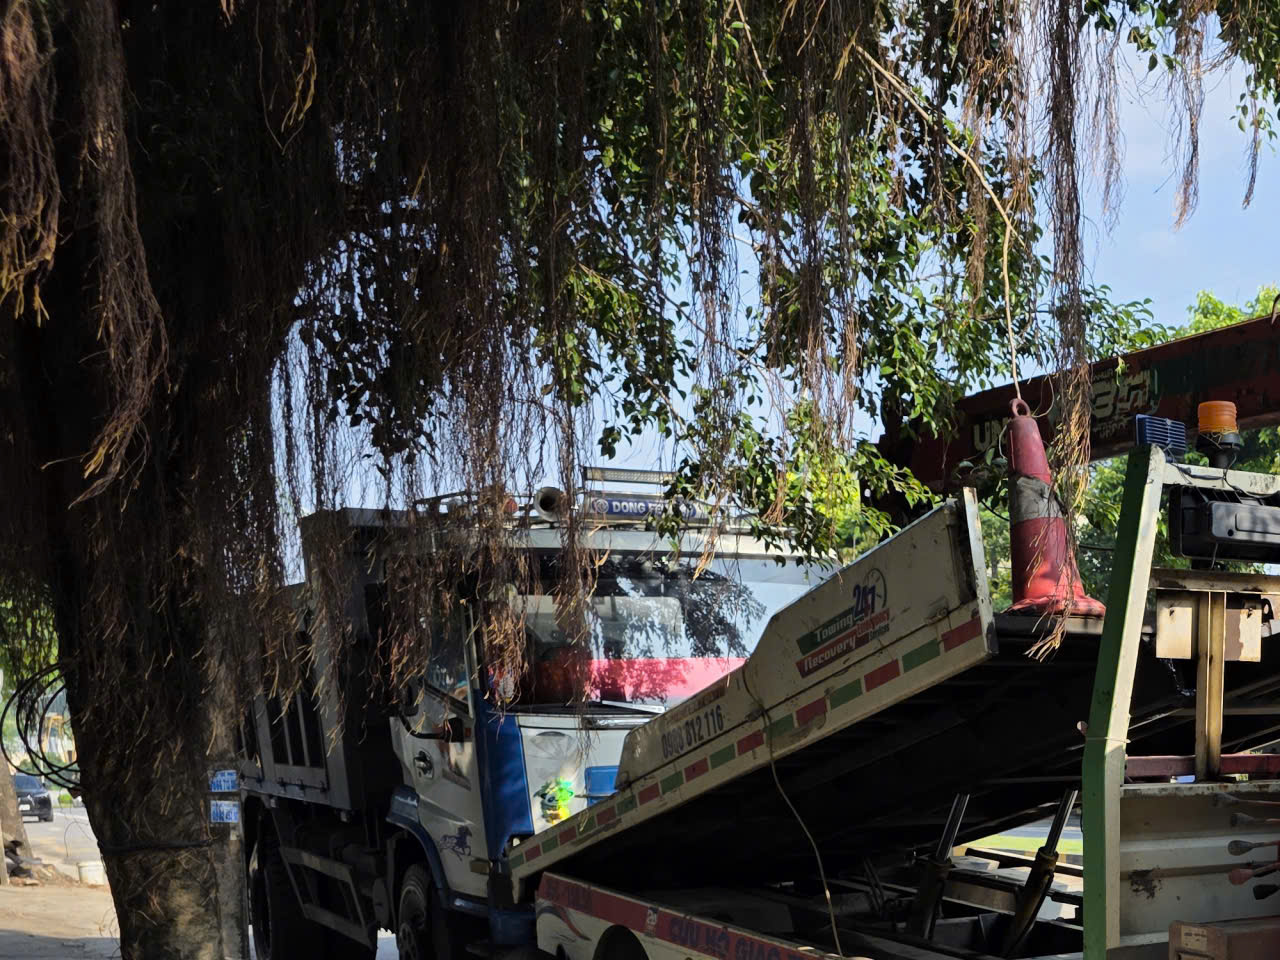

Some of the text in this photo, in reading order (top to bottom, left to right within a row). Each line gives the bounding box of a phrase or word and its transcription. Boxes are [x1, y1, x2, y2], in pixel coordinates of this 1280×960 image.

[612, 501, 646, 513] DONG
[815, 613, 854, 642] Towing
[804, 635, 856, 672] Recovery
[704, 704, 724, 737] 116
